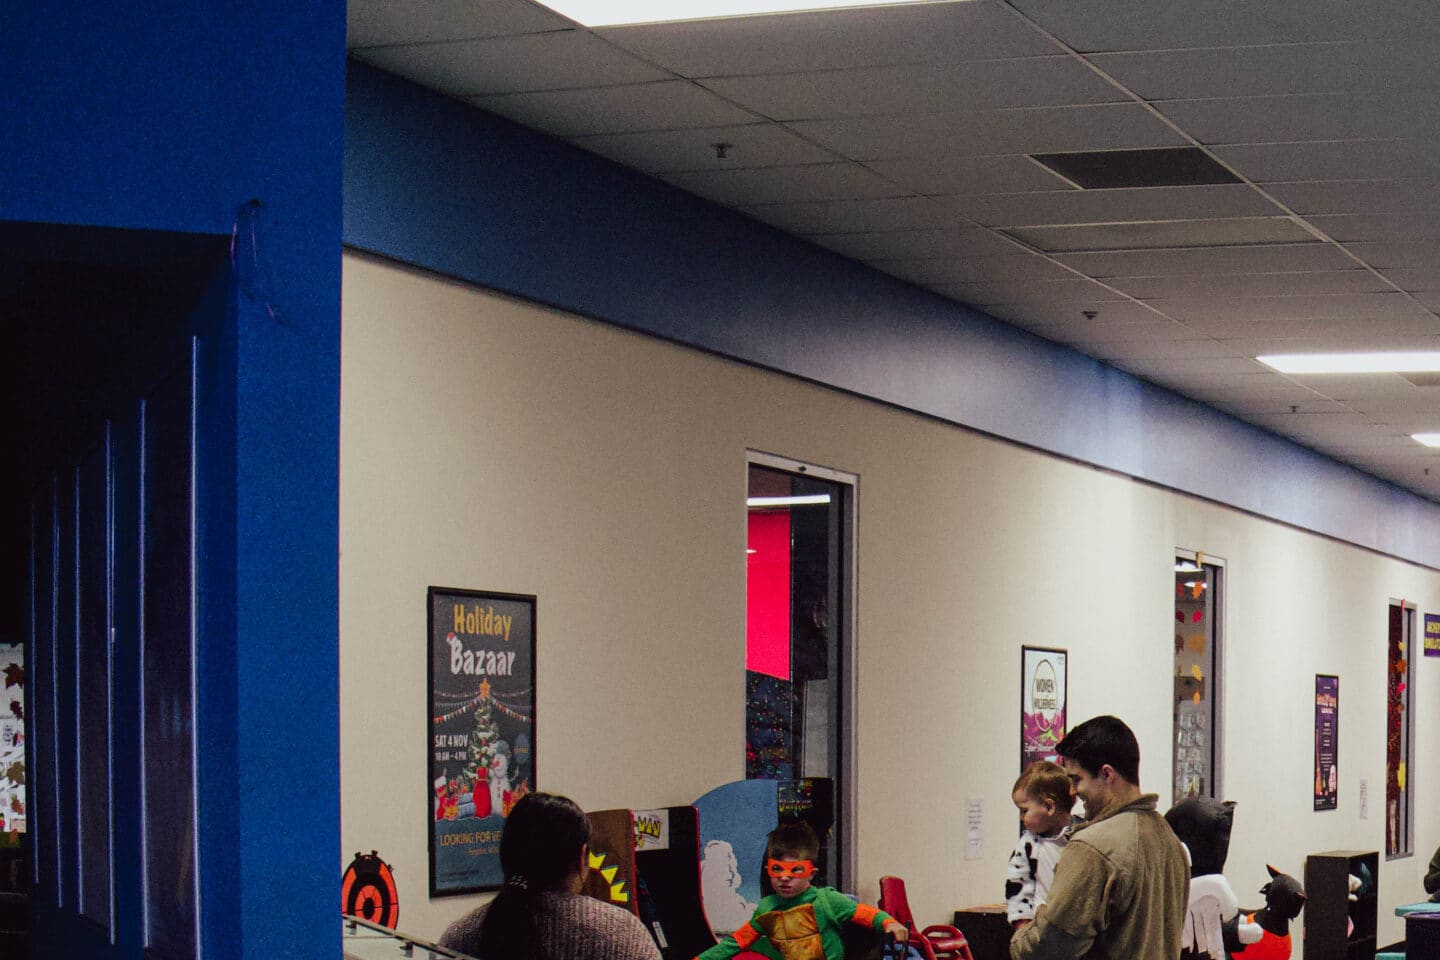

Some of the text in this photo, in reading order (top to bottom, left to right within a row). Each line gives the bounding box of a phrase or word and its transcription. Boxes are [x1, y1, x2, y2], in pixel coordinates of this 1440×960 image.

[453, 604, 513, 641] Holiday
[449, 637, 516, 677] Bazaar
[1035, 679, 1055, 693] WOMEN
[434, 734, 469, 748] SAT 4 NOV
[440, 832, 474, 847] LOOKING
[475, 831, 491, 844] FOR
